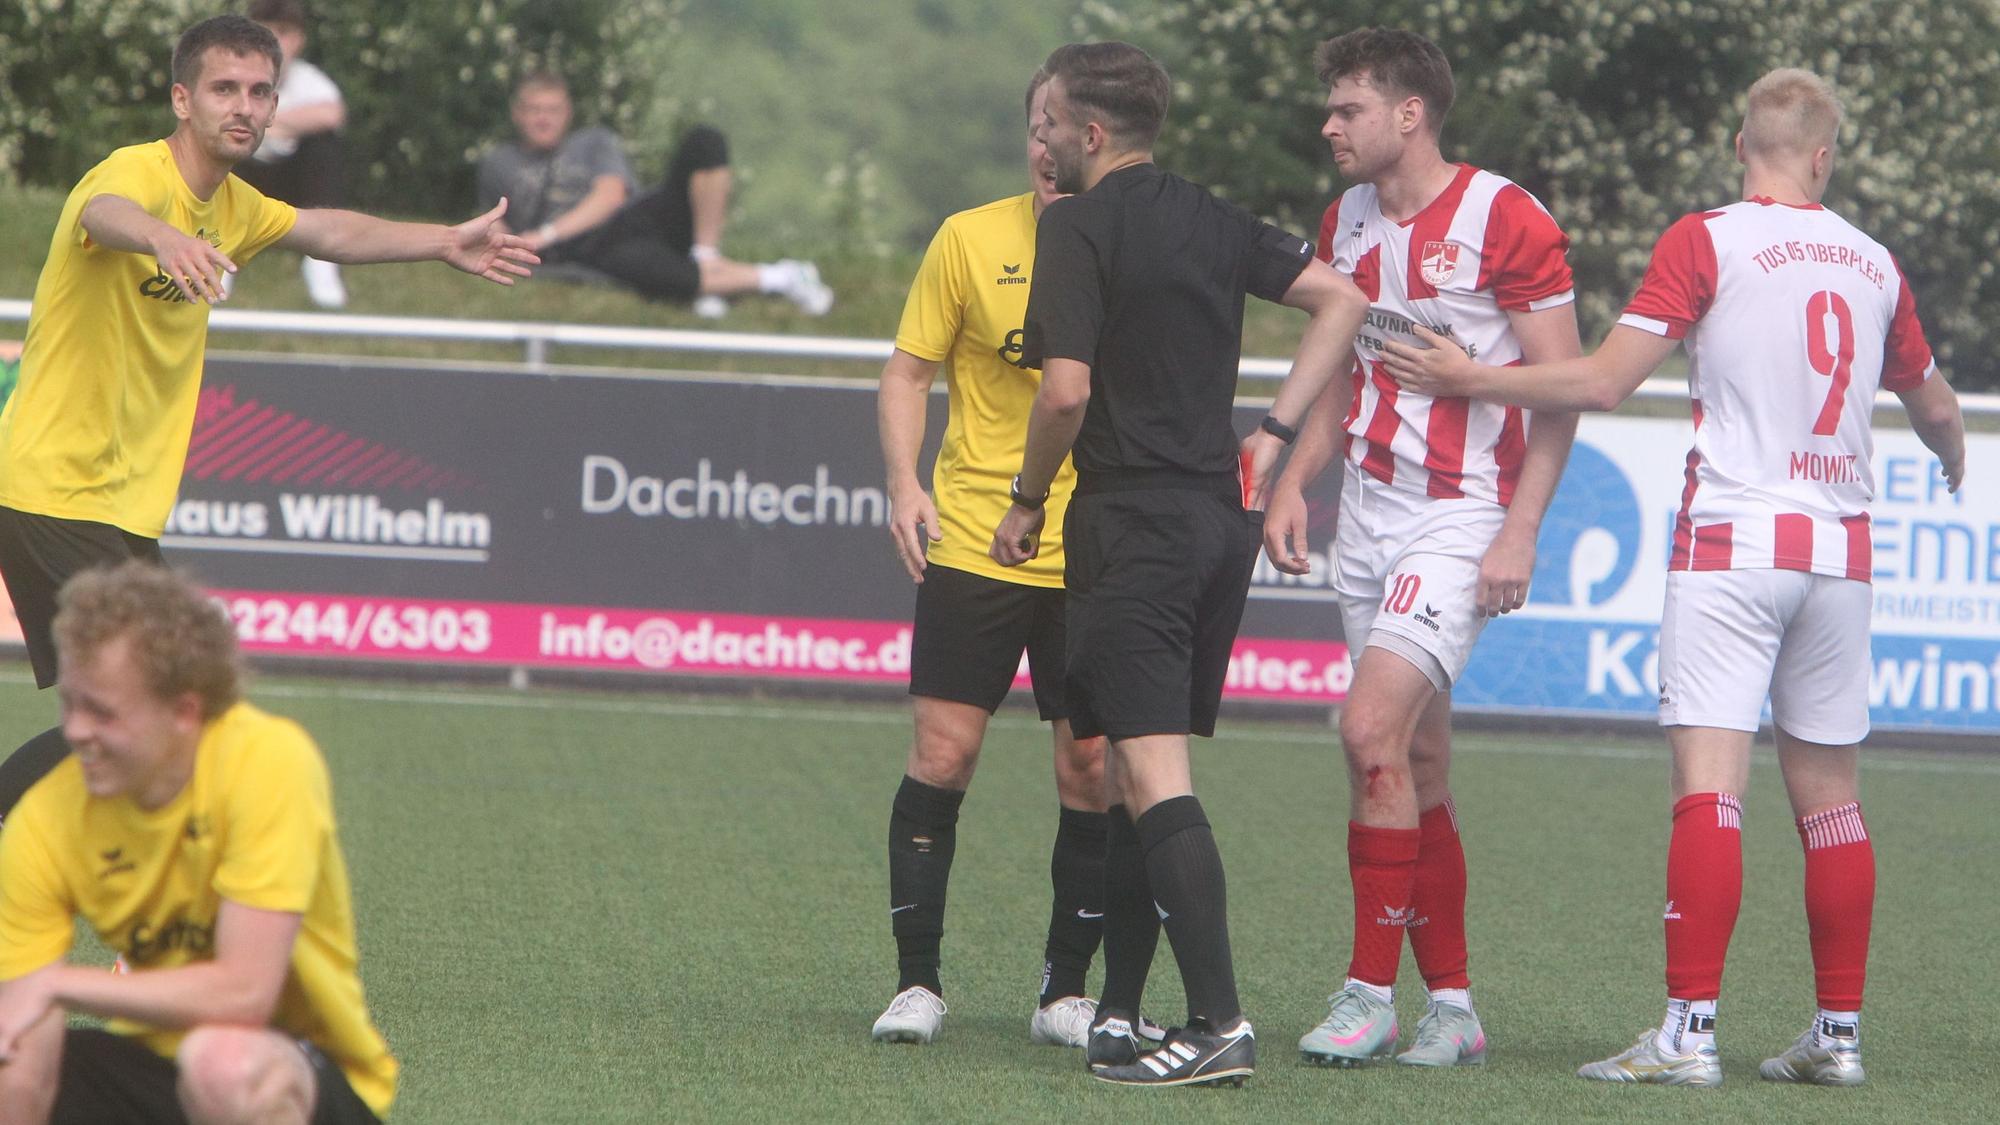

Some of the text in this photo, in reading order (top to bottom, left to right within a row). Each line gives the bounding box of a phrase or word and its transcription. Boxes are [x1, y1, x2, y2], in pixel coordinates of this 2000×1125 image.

[997, 276, 1027, 285] erima
[1753, 241, 1885, 290] TUS 05 OBERPLEIS
[1806, 290, 1855, 436] 9
[581, 455, 892, 526] Dachtechn
[279, 493, 491, 547] Wilhelm
[1384, 573, 1421, 615] 10
[540, 611, 911, 673] info@dachtec.d
[1413, 613, 1440, 632] erima
